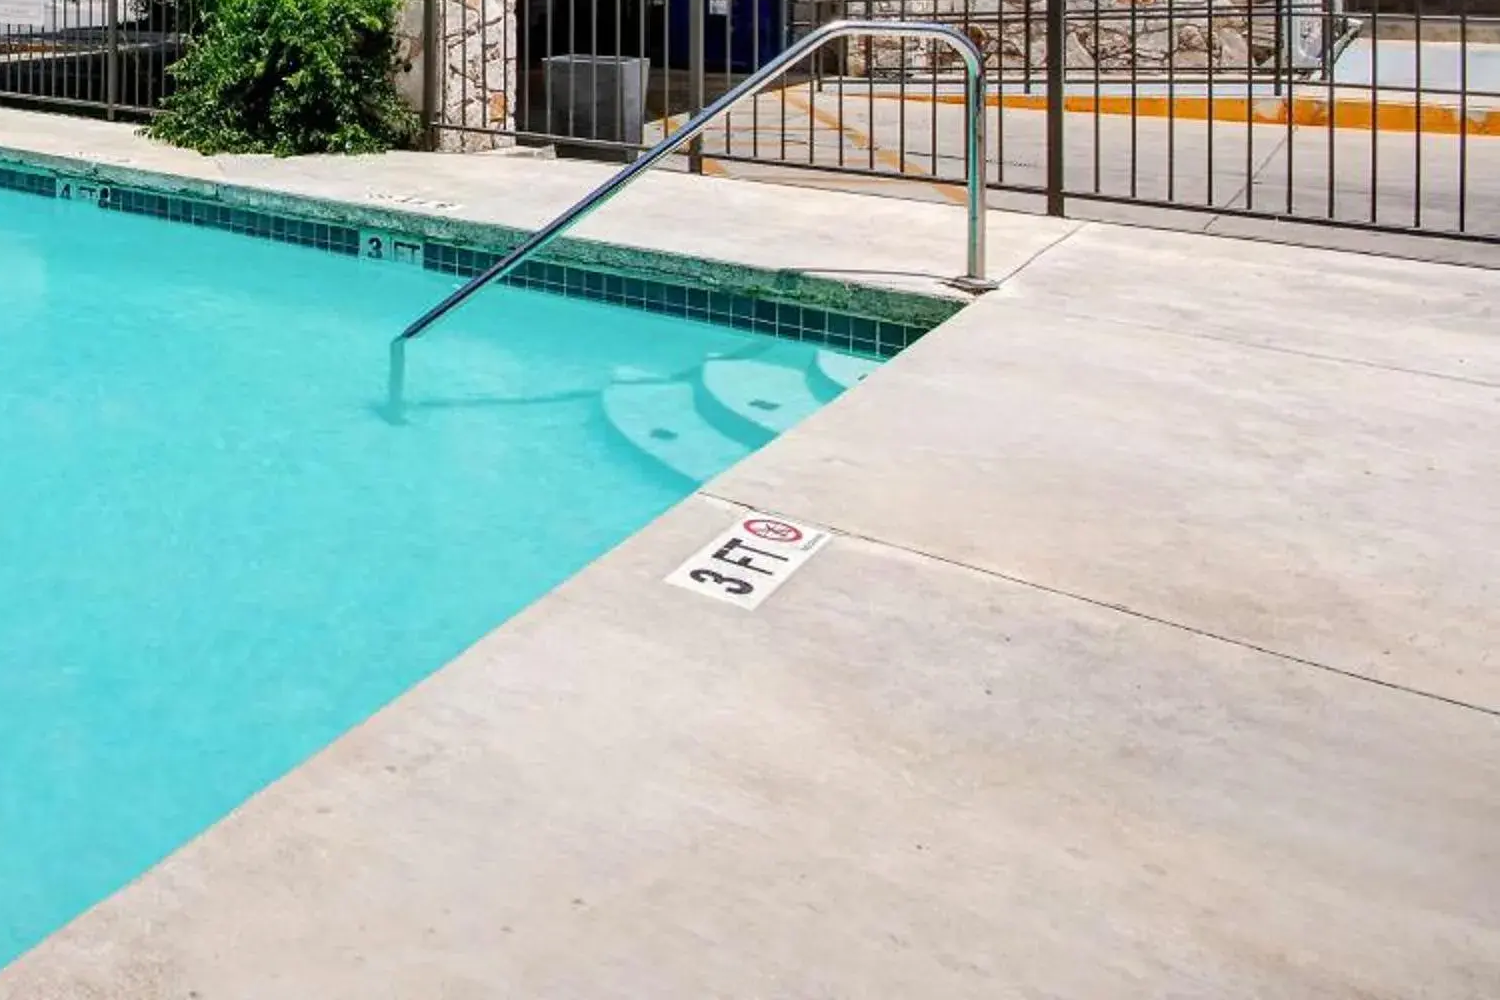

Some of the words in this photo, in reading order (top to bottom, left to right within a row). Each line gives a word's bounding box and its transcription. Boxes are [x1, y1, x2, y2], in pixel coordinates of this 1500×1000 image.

[368, 237, 383, 259] 3
[712, 537, 790, 576] FT
[689, 568, 754, 595] 3
